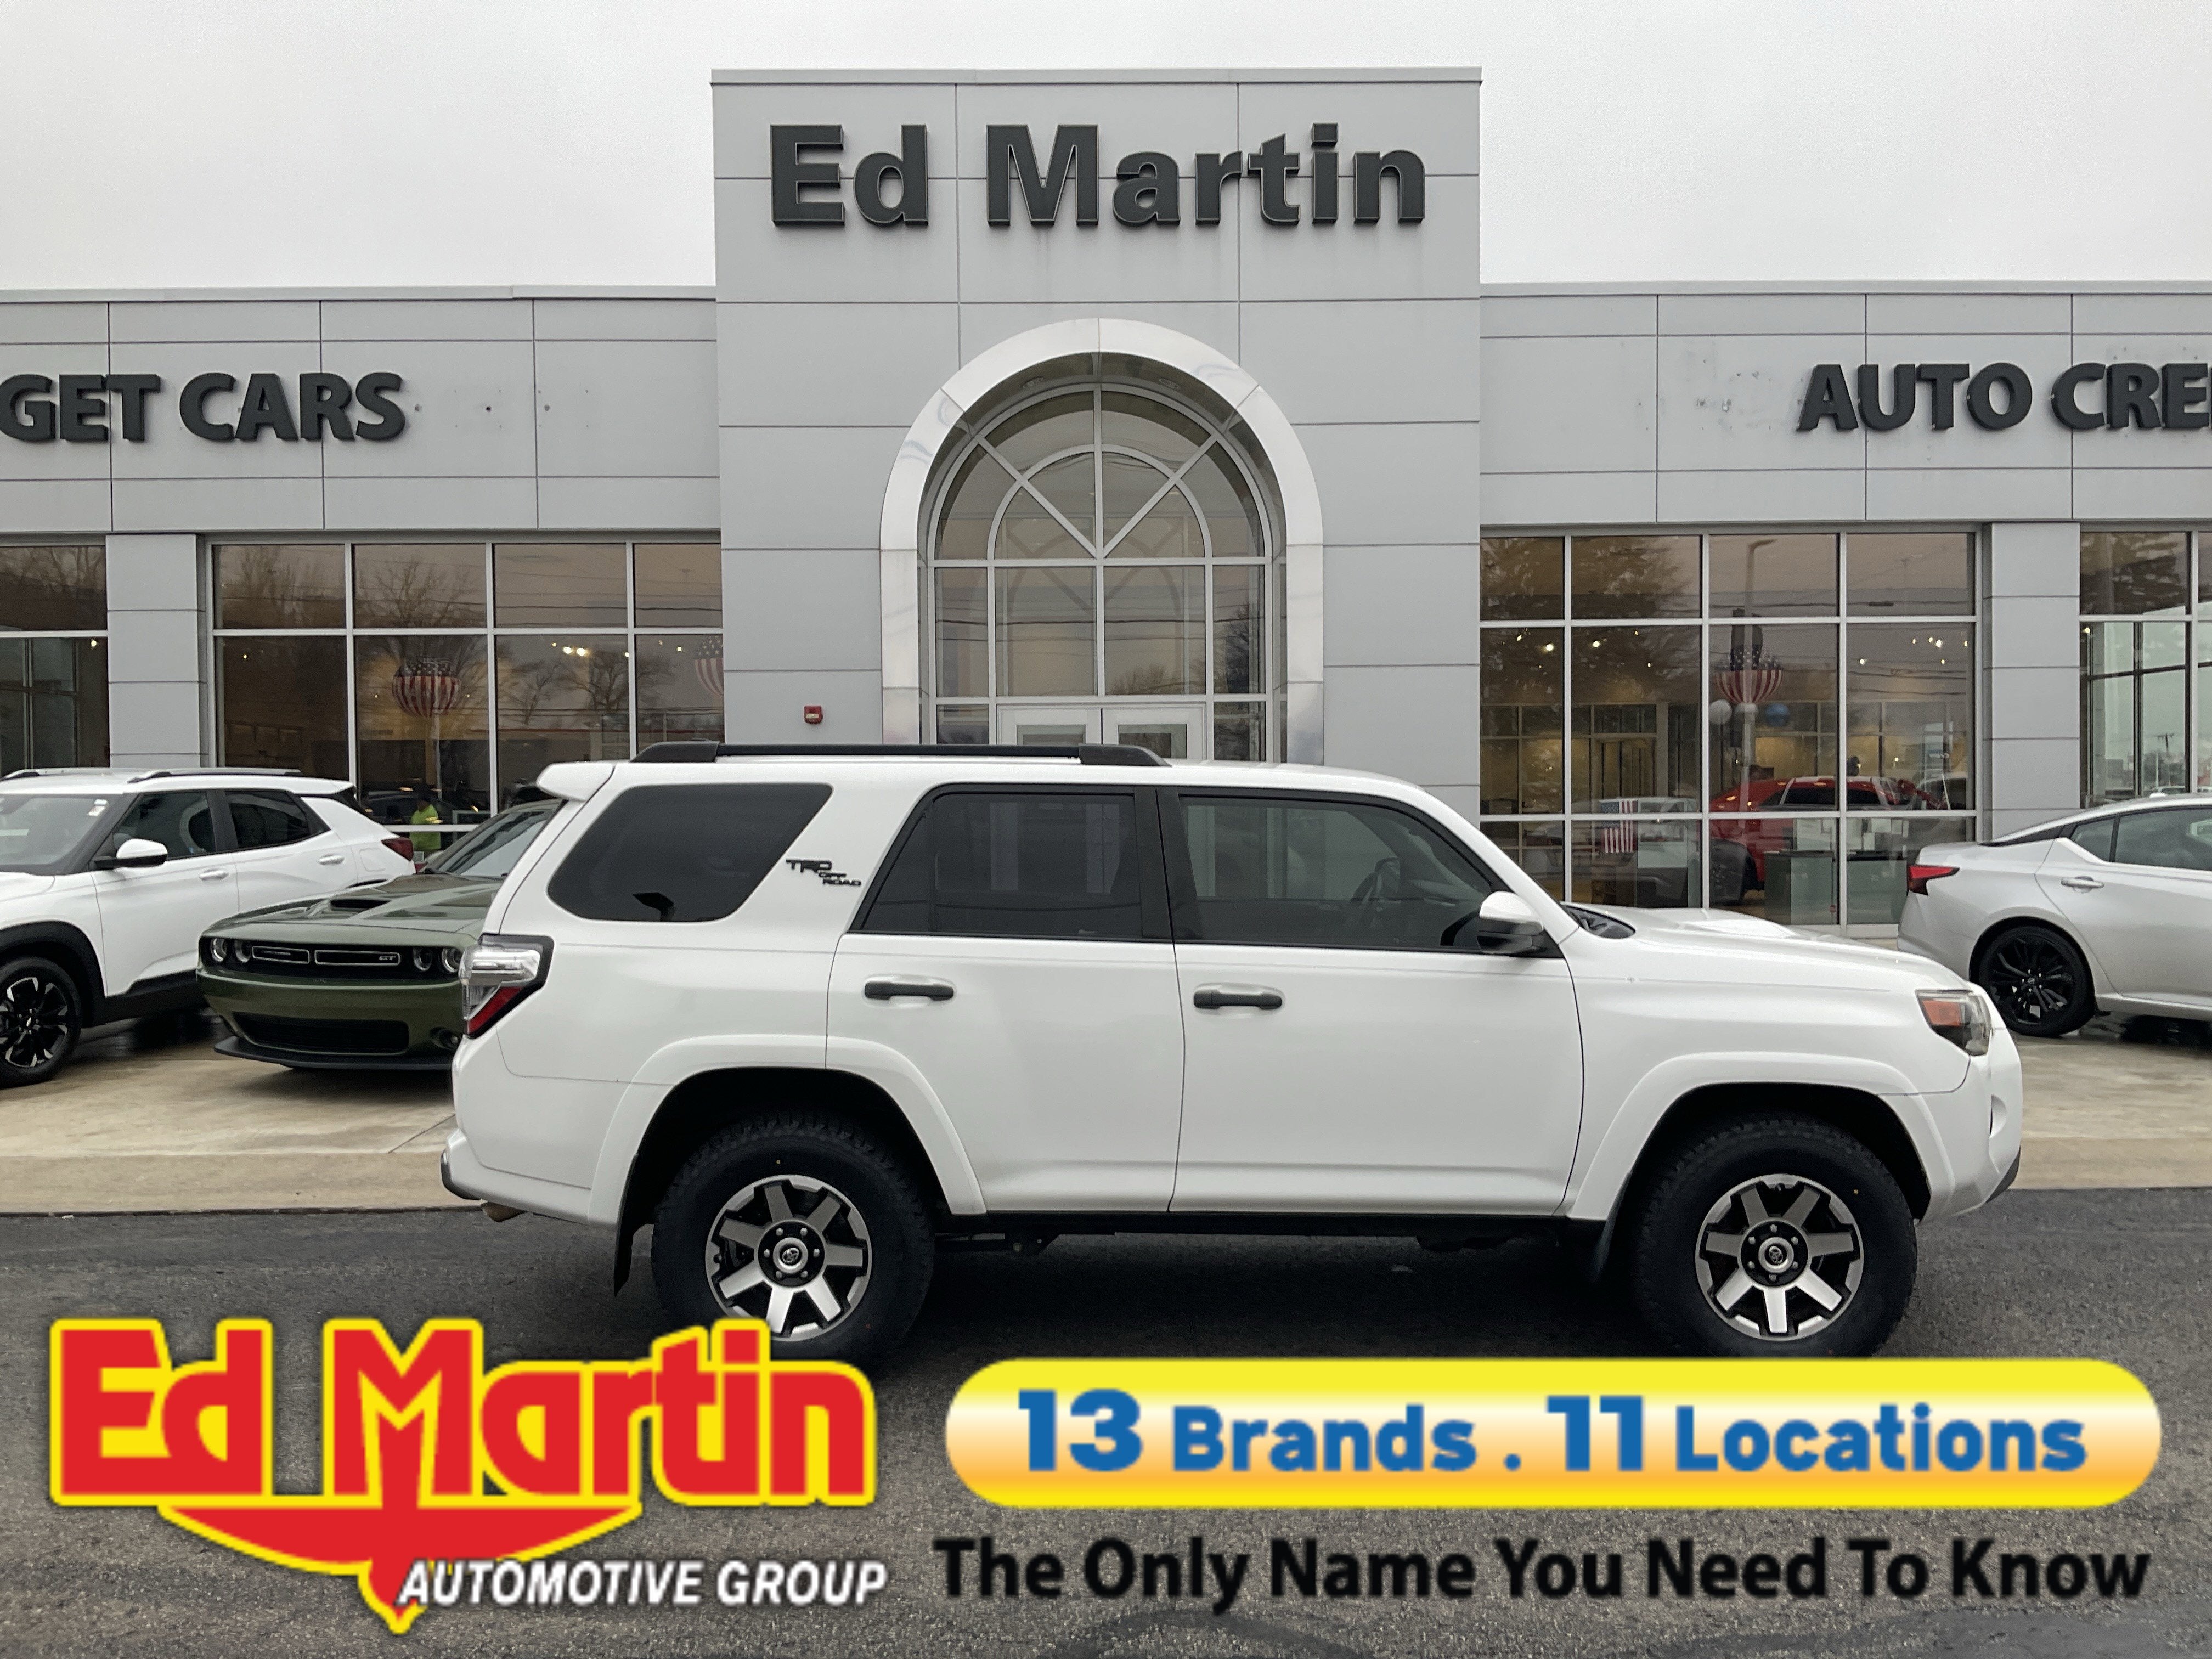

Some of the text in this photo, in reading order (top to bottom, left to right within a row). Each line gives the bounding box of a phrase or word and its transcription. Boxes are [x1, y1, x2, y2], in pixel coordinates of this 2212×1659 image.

[770, 123, 1426, 227] Ed Martin
[0, 372, 407, 443] GET CARS
[1797, 362, 2212, 431] AUTO CRE
[786, 859, 832, 873] TRD
